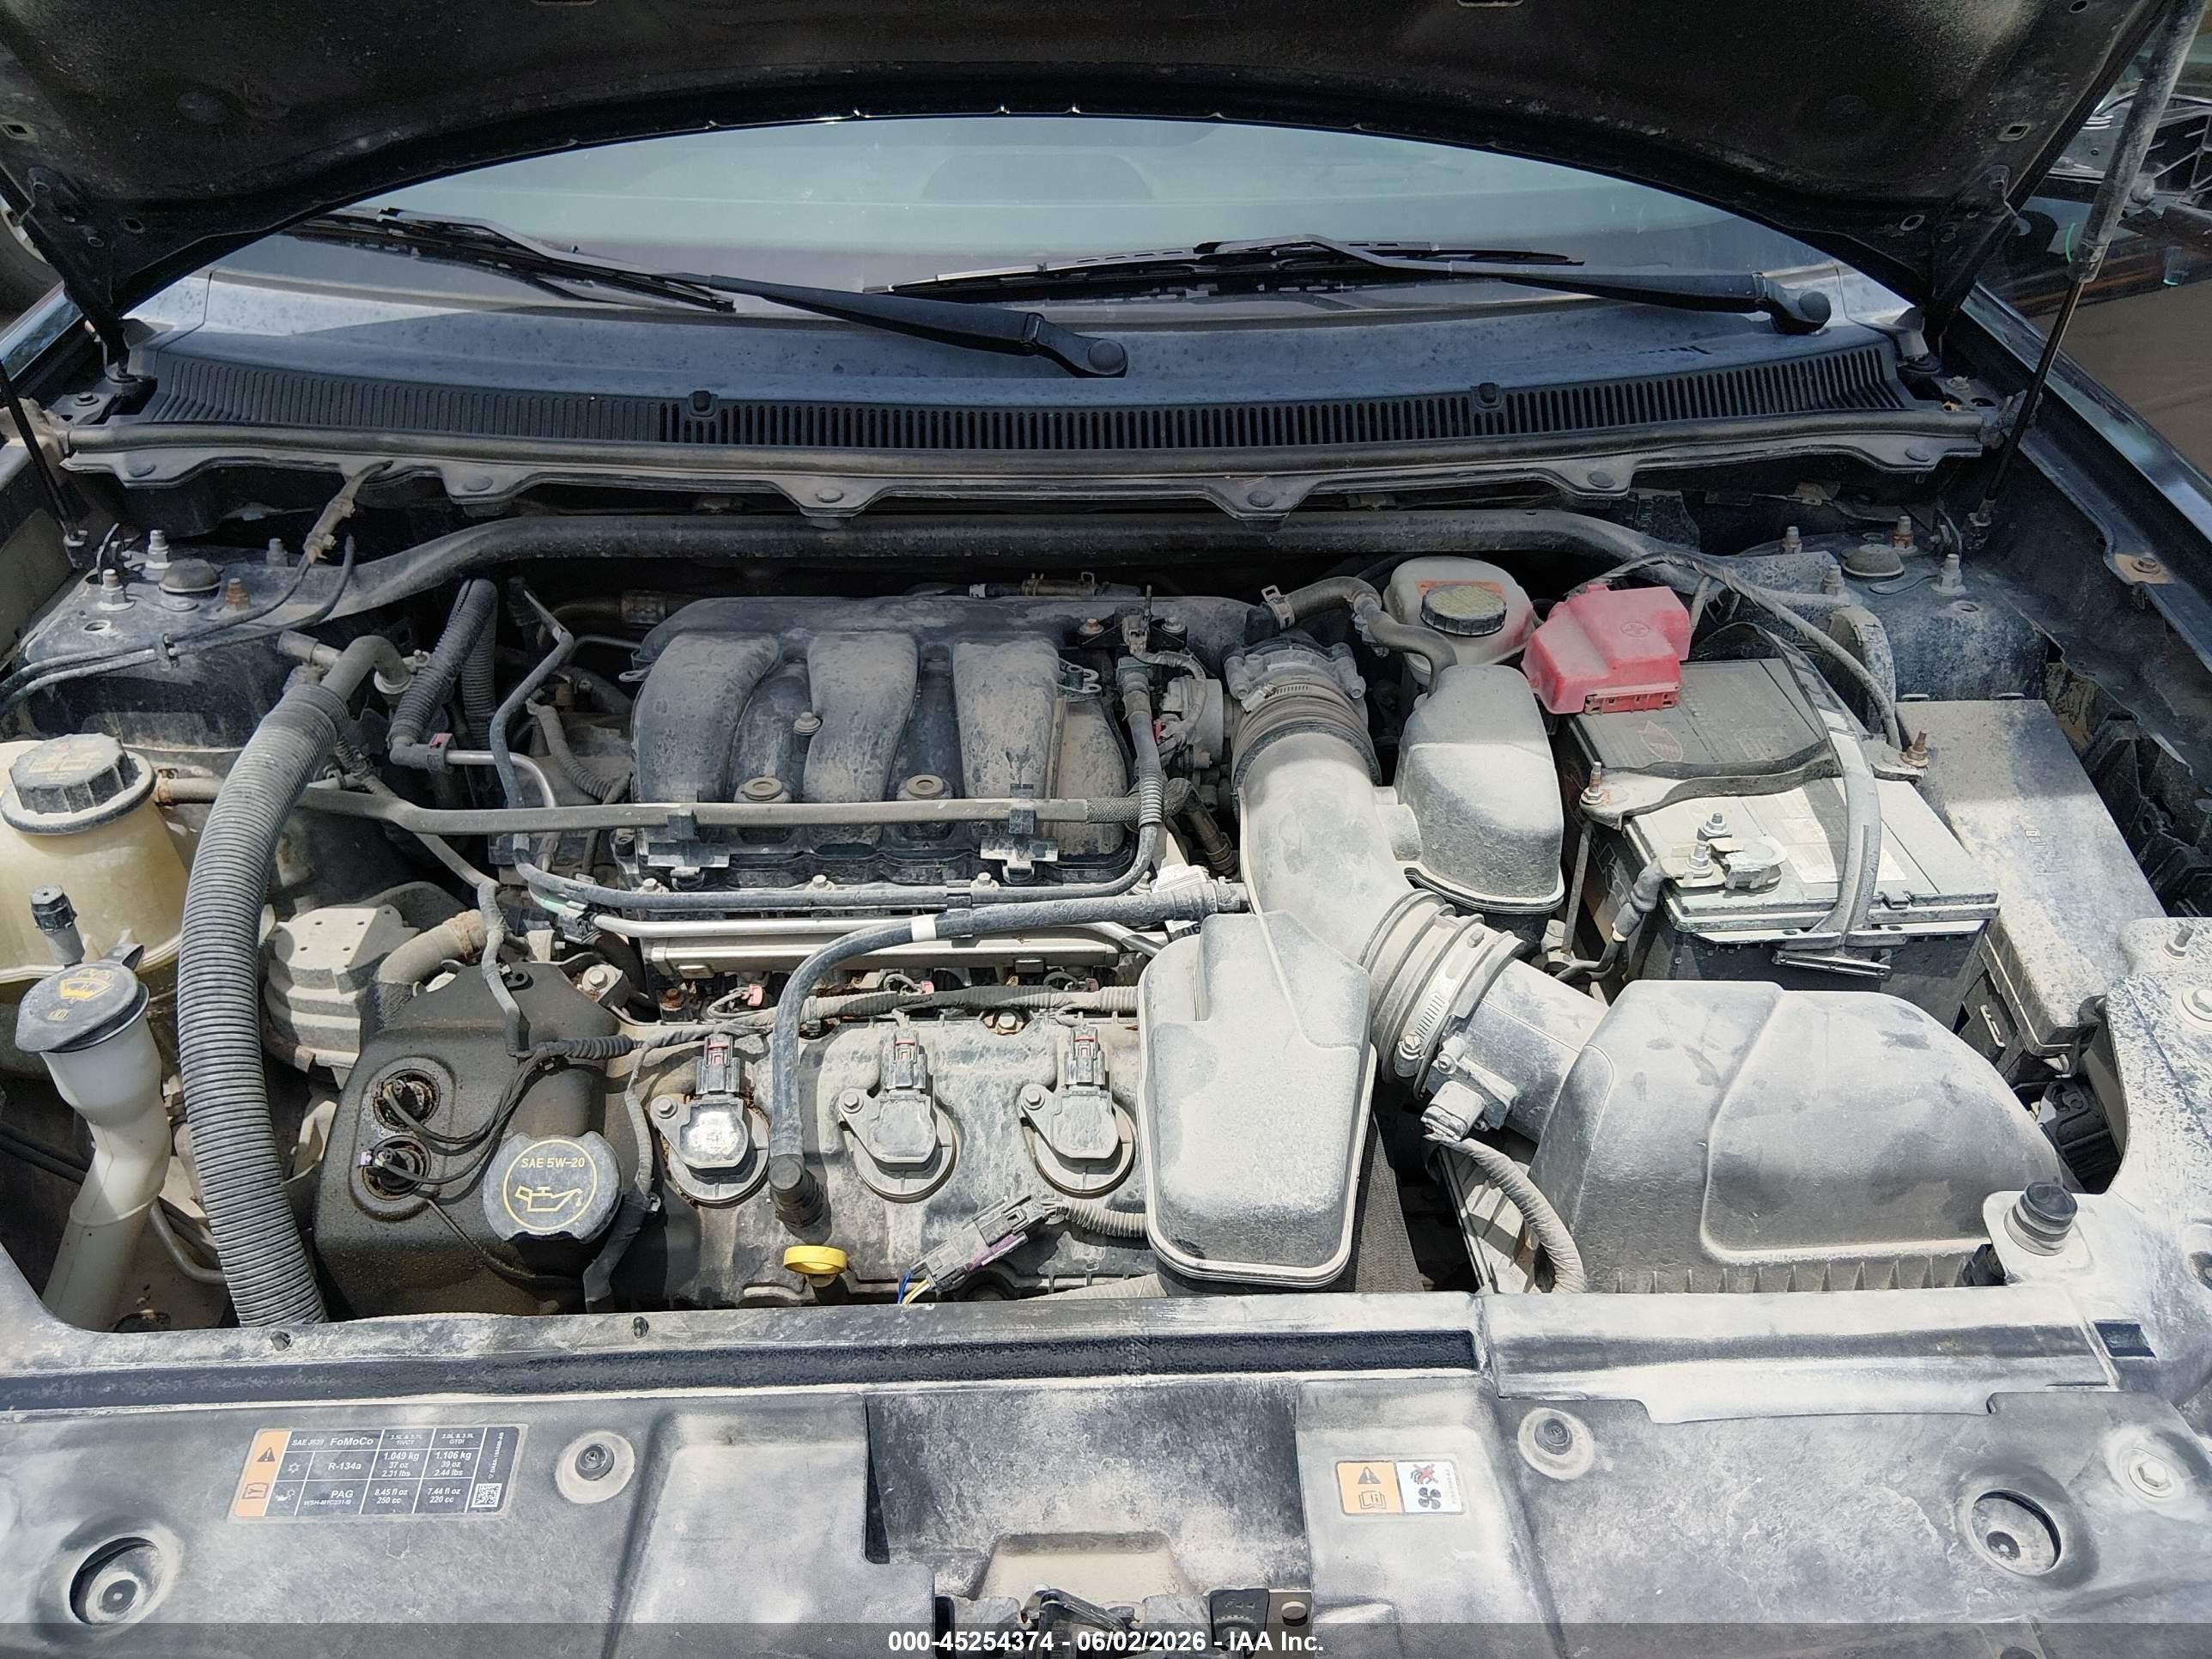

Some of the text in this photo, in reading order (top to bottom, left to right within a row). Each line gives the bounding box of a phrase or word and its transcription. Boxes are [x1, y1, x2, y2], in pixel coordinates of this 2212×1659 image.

[521, 1158, 585, 1168] SAE 5W-20
[330, 1437, 374, 1446] FoMoCo
[384, 1451, 420, 1462] 1.049 kg
[434, 1450, 472, 1462] 1.106 kg
[331, 1490, 354, 1498] PAG
